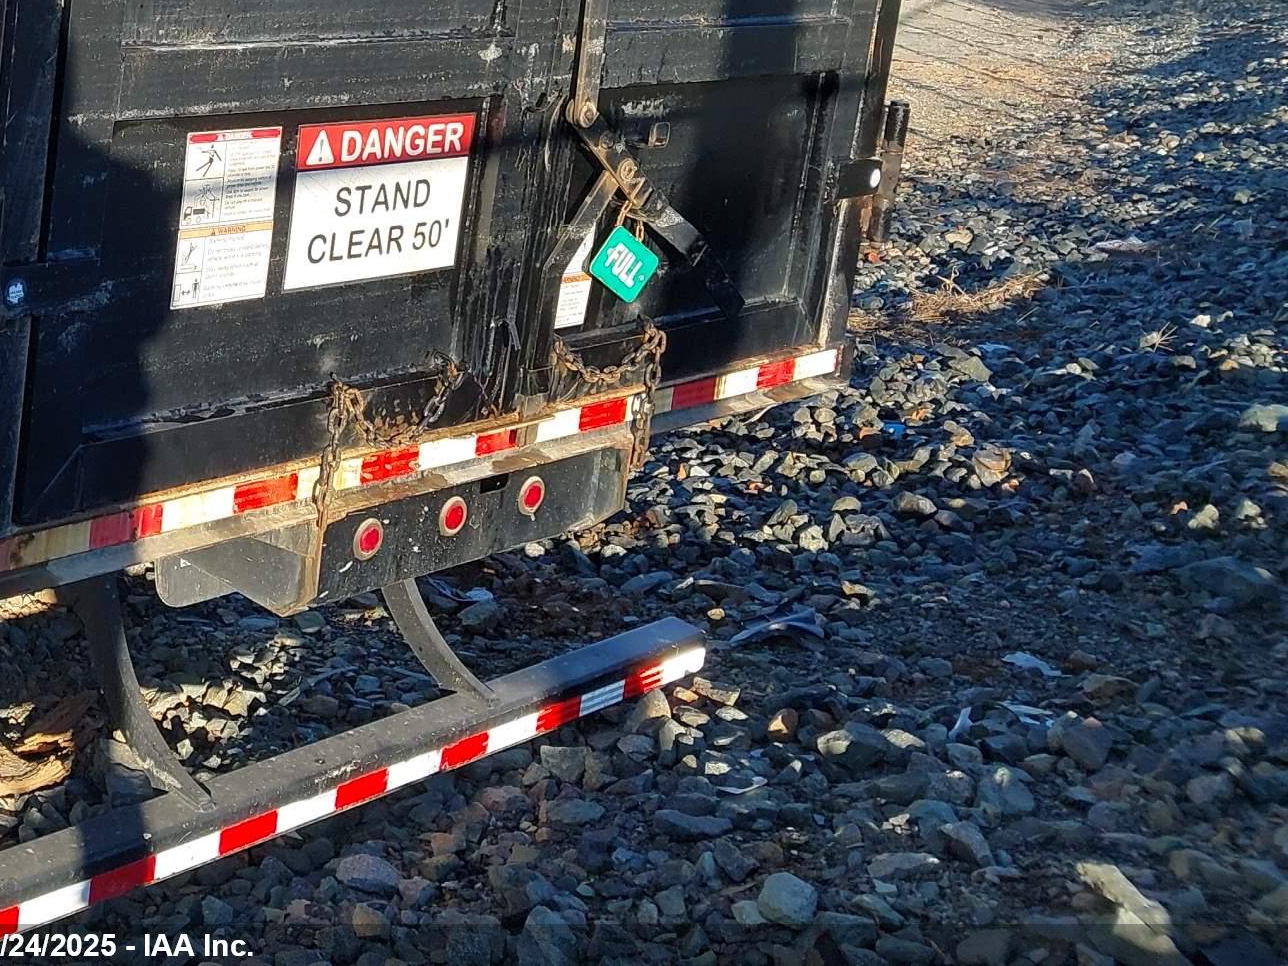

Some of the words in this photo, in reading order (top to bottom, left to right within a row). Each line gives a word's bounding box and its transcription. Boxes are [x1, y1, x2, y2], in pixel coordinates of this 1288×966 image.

[341, 122, 464, 162] DANGER
[334, 179, 431, 217] STAND
[307, 225, 404, 264] CLEAR
[412, 218, 450, 251] 50'
